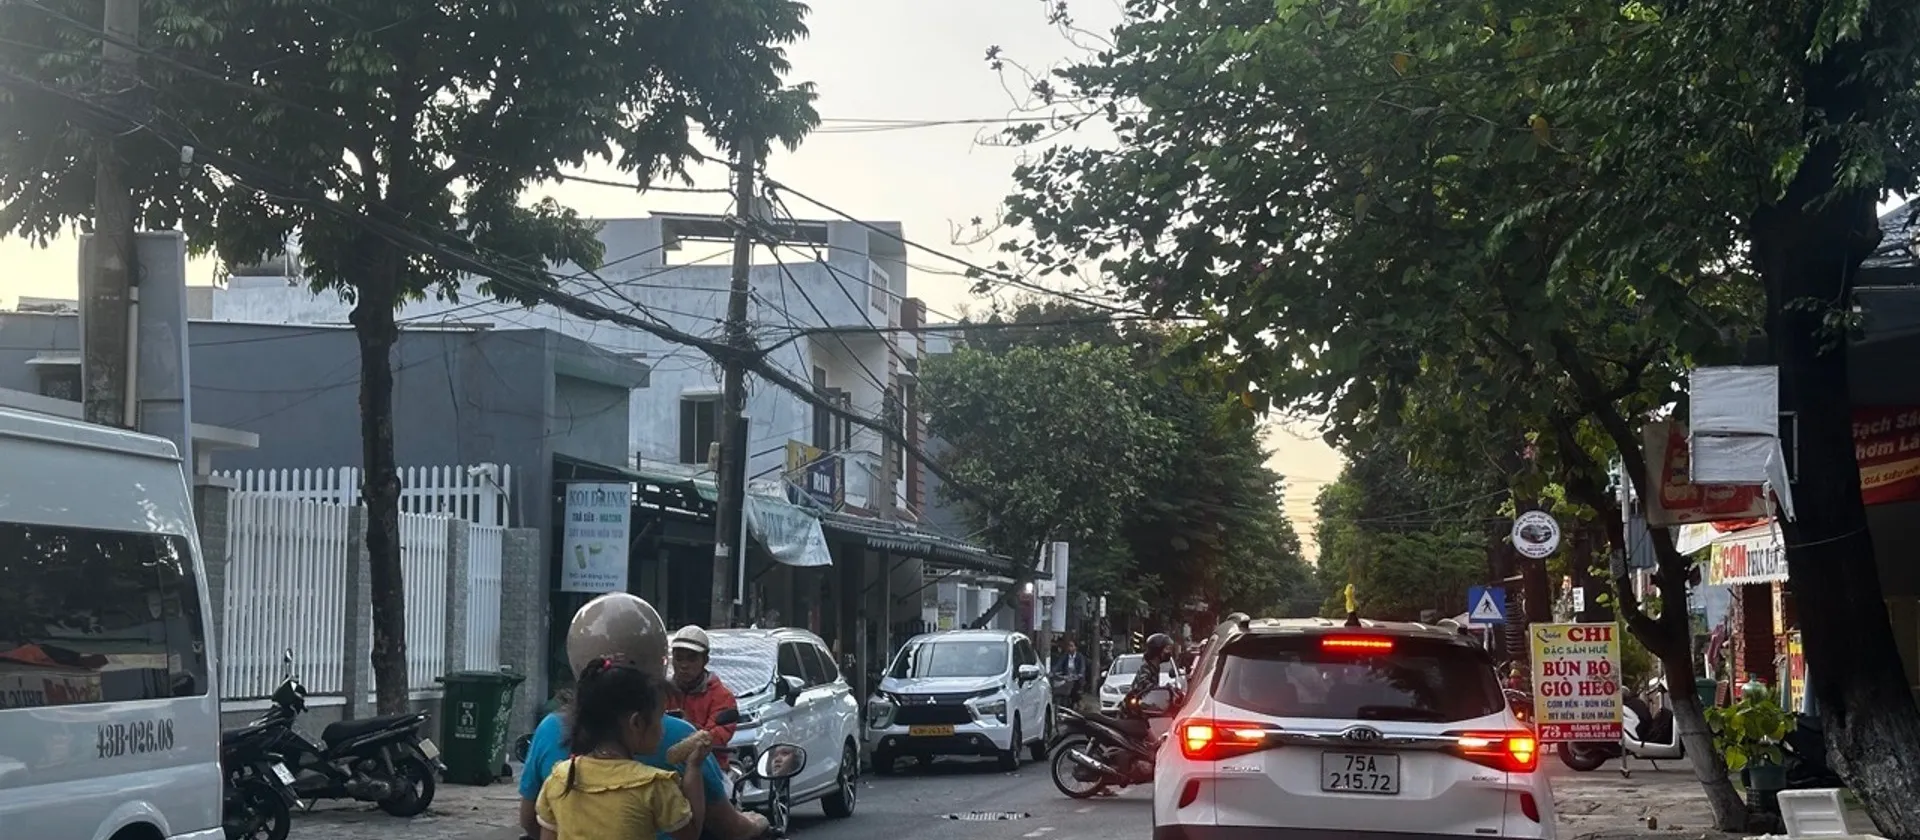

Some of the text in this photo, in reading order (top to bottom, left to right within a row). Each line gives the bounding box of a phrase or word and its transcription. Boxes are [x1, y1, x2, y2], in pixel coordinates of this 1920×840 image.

[1567, 627, 1612, 642] CHI
[1543, 656, 1611, 676] BÚN BÒ
[1541, 677, 1573, 696] GIÒ
[1351, 730, 1374, 740] KIA
[1541, 725, 1561, 738] 73
[1344, 755, 1377, 772] 75A
[1329, 772, 1391, 791] 215.72
